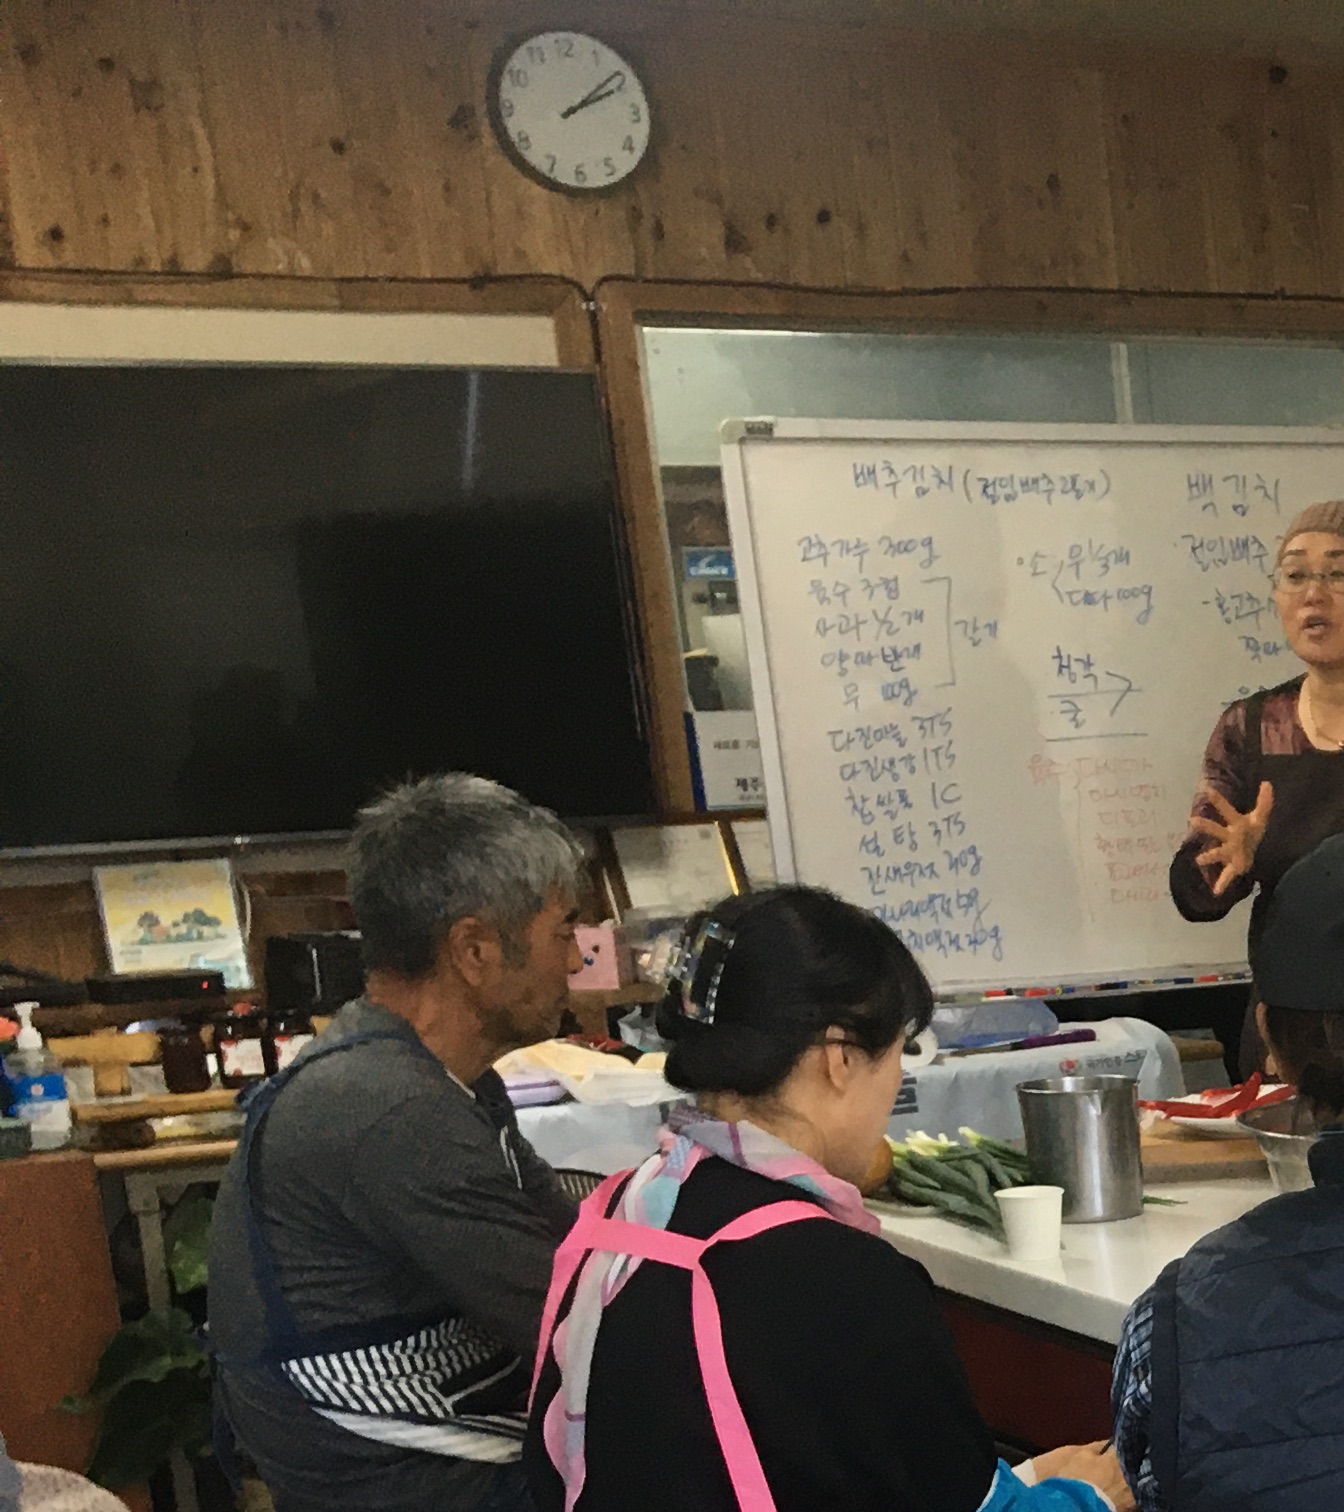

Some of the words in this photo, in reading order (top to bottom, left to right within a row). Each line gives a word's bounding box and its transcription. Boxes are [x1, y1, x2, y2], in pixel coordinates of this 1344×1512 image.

[629, 102, 642, 124] 3
[622, 134, 635, 155] 4
[545, 154, 557, 175] 7
[574, 162, 588, 184] 6
[603, 156, 617, 177] 5
